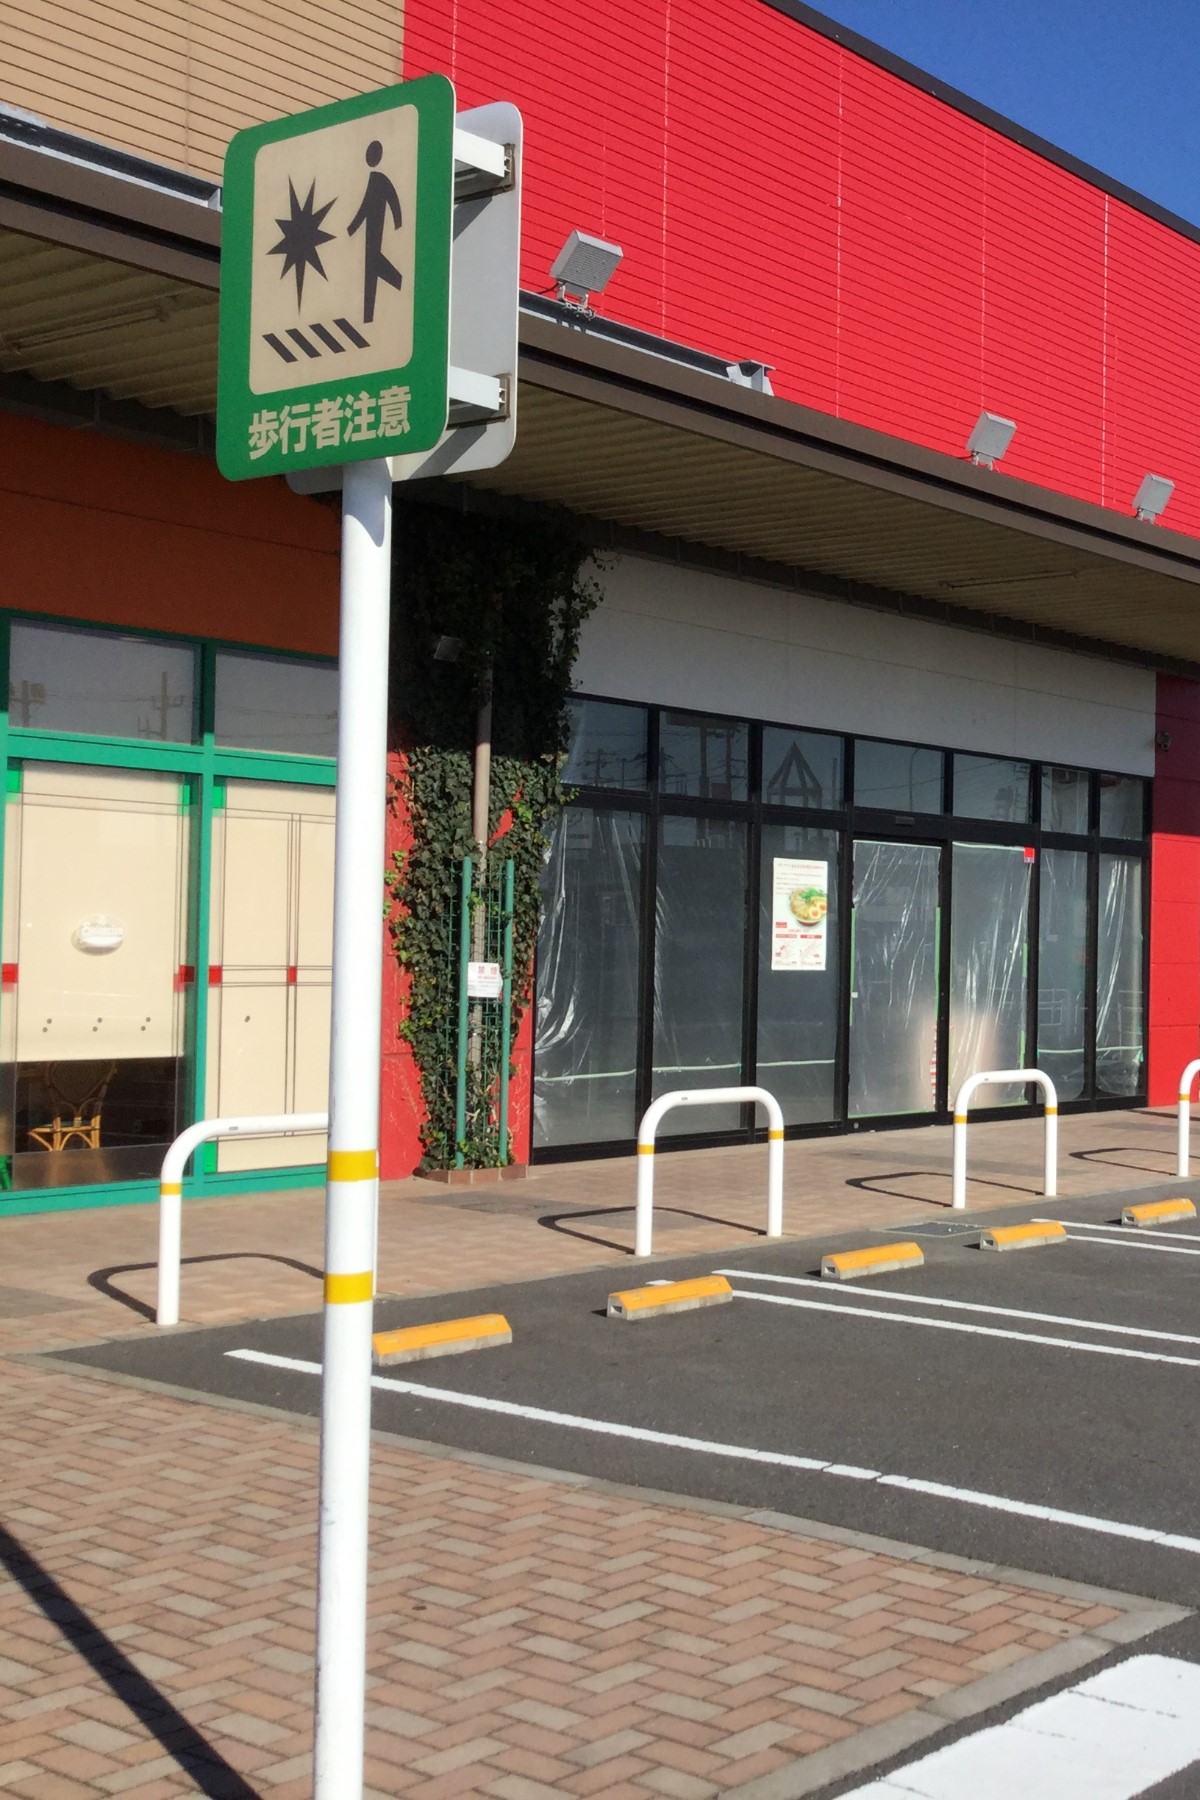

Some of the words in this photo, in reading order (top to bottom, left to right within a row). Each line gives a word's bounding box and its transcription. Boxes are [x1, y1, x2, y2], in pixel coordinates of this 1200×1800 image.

[248, 385, 412, 460] 歩行者注意
